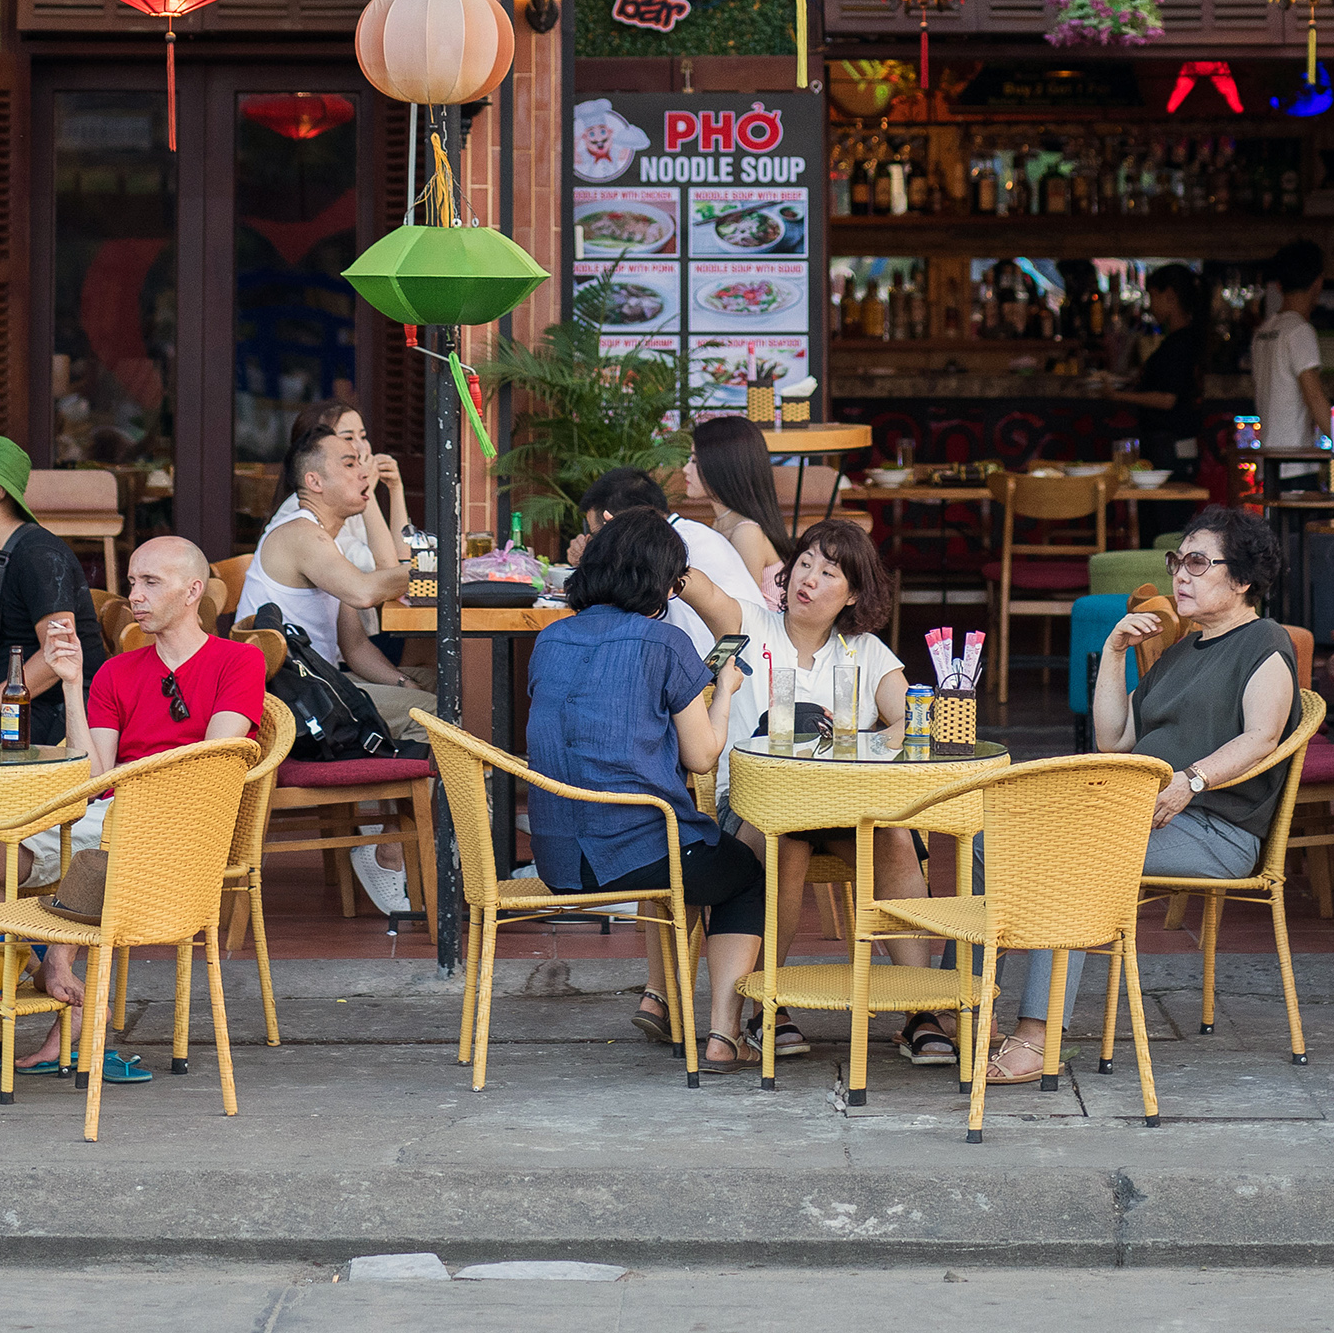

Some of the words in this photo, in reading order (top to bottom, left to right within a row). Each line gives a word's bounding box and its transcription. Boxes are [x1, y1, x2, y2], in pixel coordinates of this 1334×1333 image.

[664, 102, 783, 153] PHỞ
[640, 156, 734, 183] NOODLE
[740, 156, 806, 183] SOUP
[695, 191, 728, 201] NOODLE
[732, 191, 753, 201] SOUP
[758, 191, 777, 201] WITH
[781, 191, 801, 201] BEEF
[696, 264, 728, 273] NOODLE
[732, 264, 752, 273] SOUP
[756, 264, 775, 273] WITH
